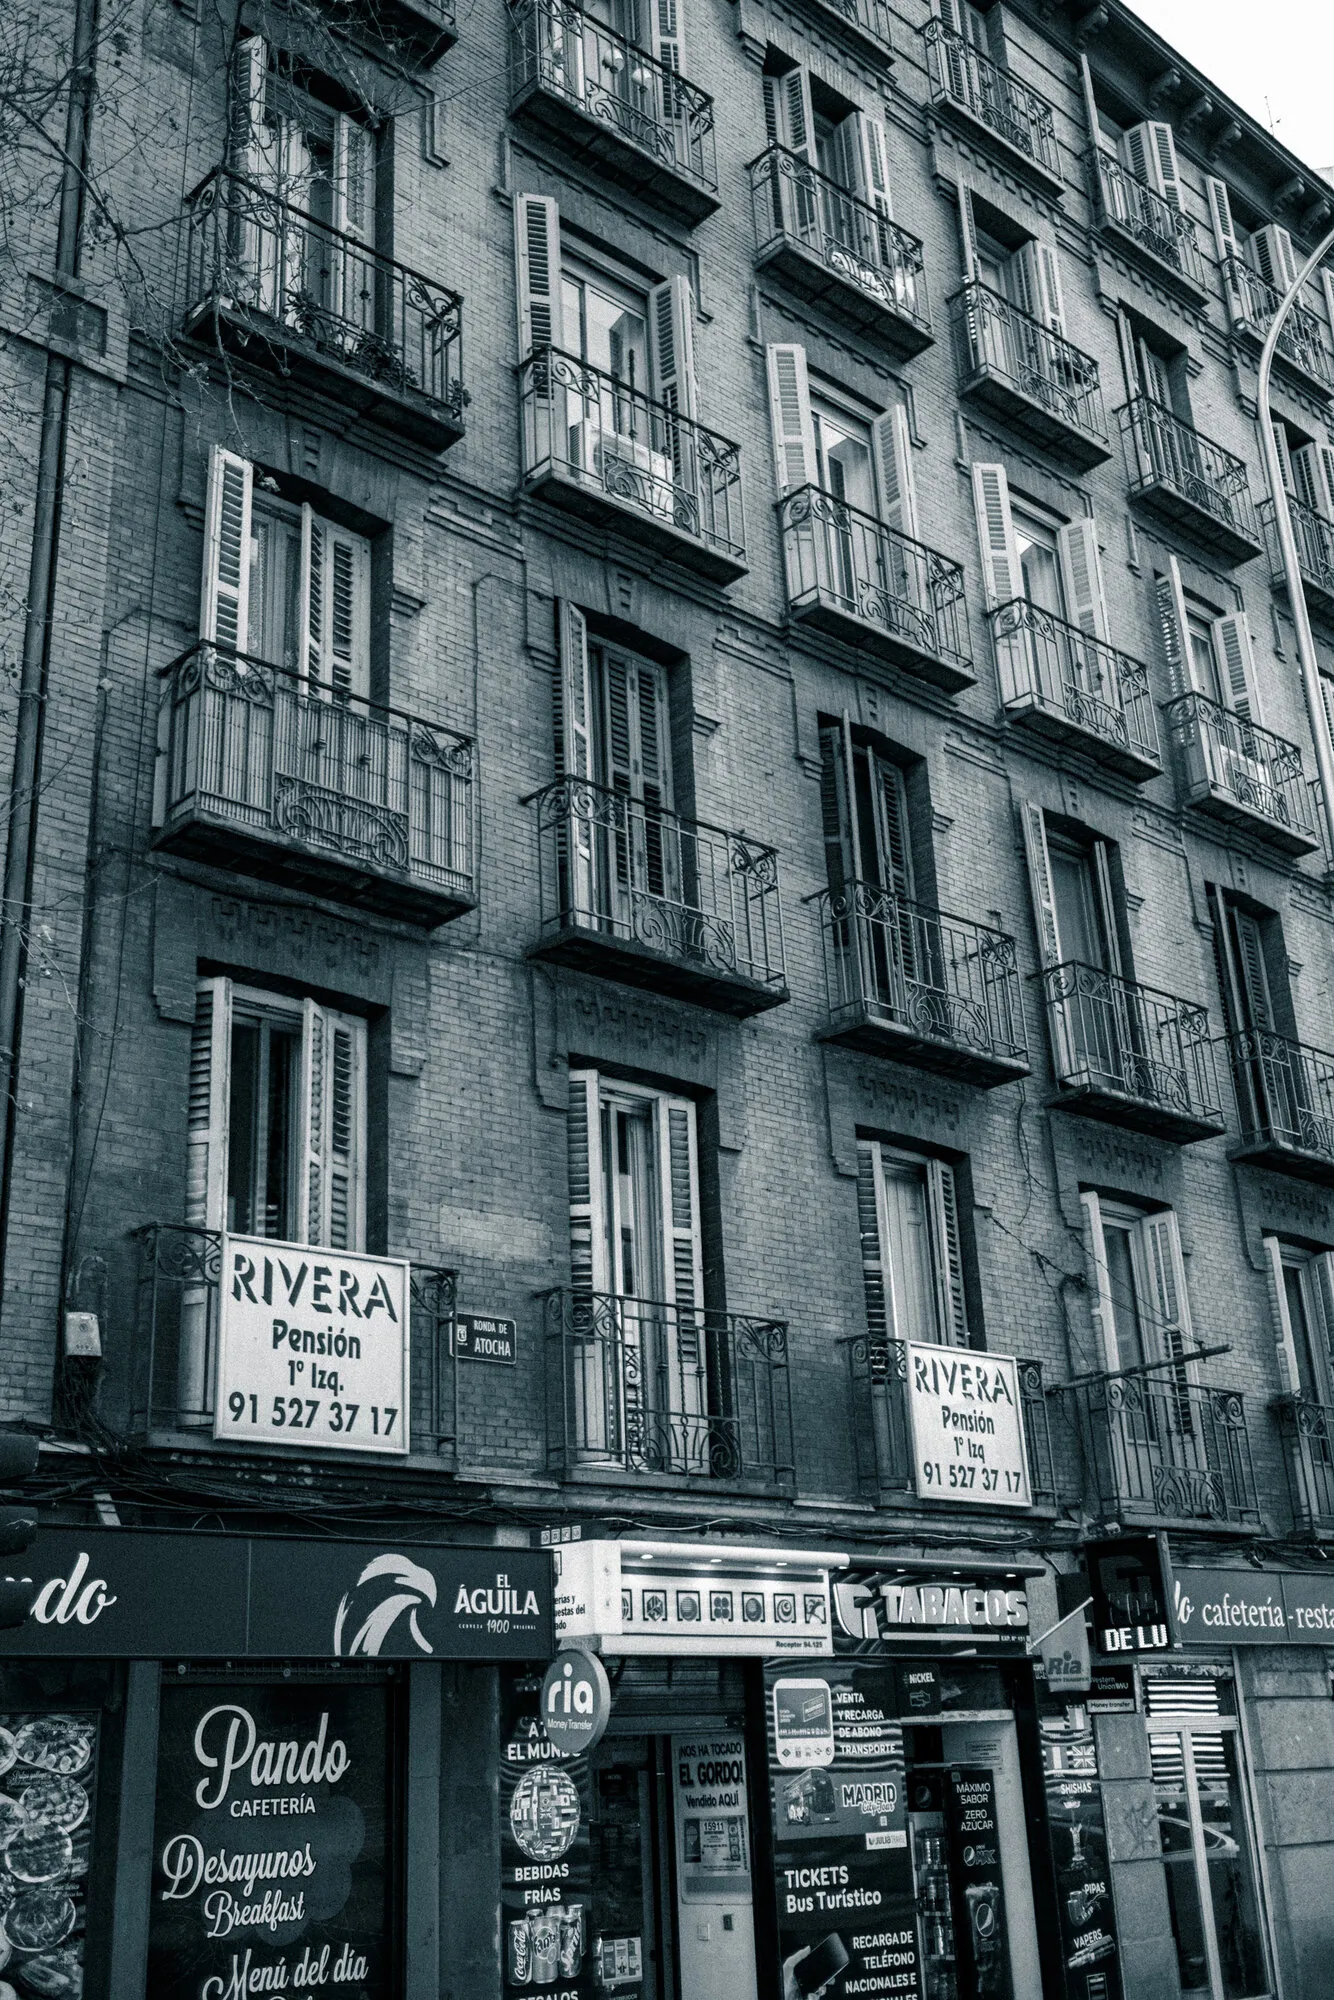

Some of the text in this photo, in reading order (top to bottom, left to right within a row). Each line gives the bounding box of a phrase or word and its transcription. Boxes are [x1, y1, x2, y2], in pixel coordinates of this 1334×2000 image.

[230, 1253, 399, 1324] RIVERA
[473, 1319, 508, 1335] RONDA DE
[272, 1318, 361, 1360] Pensión
[474, 1337, 511, 1357] ATOCHA
[311, 1362, 344, 1397] Izq.
[914, 1356, 1014, 1406] RIVERA
[228, 1391, 399, 1436] 91 527 37 17
[941, 1405, 996, 1435] Pensión
[967, 1438, 986, 1464] Izq
[923, 1461, 1021, 1493] 91 527 37 17
[4, 1551, 118, 1625] do
[496, 1574, 511, 1589] EL
[453, 1583, 540, 1616] ÁGUILA
[571, 1594, 576, 1605] y
[575, 1603, 586, 1615] del
[879, 1584, 1030, 1627] TABACOS
[1201, 1593, 1286, 1628] cafetería
[486, 1619, 511, 1634] 1900
[1104, 1623, 1169, 1652] DE LU
[1047, 1650, 1082, 1675] Ria
[547, 1662, 594, 1715] ria
[836, 1692, 865, 1704] VENTA
[547, 1718, 568, 1731] Money
[568, 1719, 593, 1730] Transfer
[837, 1709, 885, 1721] Y RECARGA
[528, 1722, 539, 1738] A
[839, 1727, 850, 1738] DE
[850, 1726, 882, 1738] ABONO
[193, 1704, 352, 1810] Pando
[507, 1742, 582, 1761] EL MUN
[698, 1744, 709, 1756] HA
[710, 1742, 742, 1756] TOCADO
[840, 1743, 897, 1755] TRANSPORTE
[679, 1760, 744, 1786] EL GORDO!
[841, 1782, 898, 1808] MADRID
[960, 1793, 989, 1804] SABOR
[1060, 1781, 1092, 1795] SHISHAS
[230, 1792, 317, 1818] CAFETERÍA
[685, 1795, 717, 1809] Vendido
[961, 1818, 994, 1832] AZÚCAR
[965, 1809, 988, 1821] ZERO
[161, 1834, 318, 1900] Desayunos
[514, 1863, 570, 1882] BEBIDAS
[784, 1865, 850, 1889] TICKETS
[524, 1885, 562, 1905] FRÍAS
[1083, 1881, 1106, 1895] PIPAS
[786, 1887, 882, 1914] Bus Turístico
[204, 1888, 305, 1938] Breakfast
[852, 1930, 914, 1950] RECARGA DE
[1073, 1928, 1103, 1949] VAPERS
[863, 1949, 916, 1970] TELÉFONO
[201, 1942, 370, 2000] Menú del día
[845, 1972, 917, 1994] NACIONALES E
